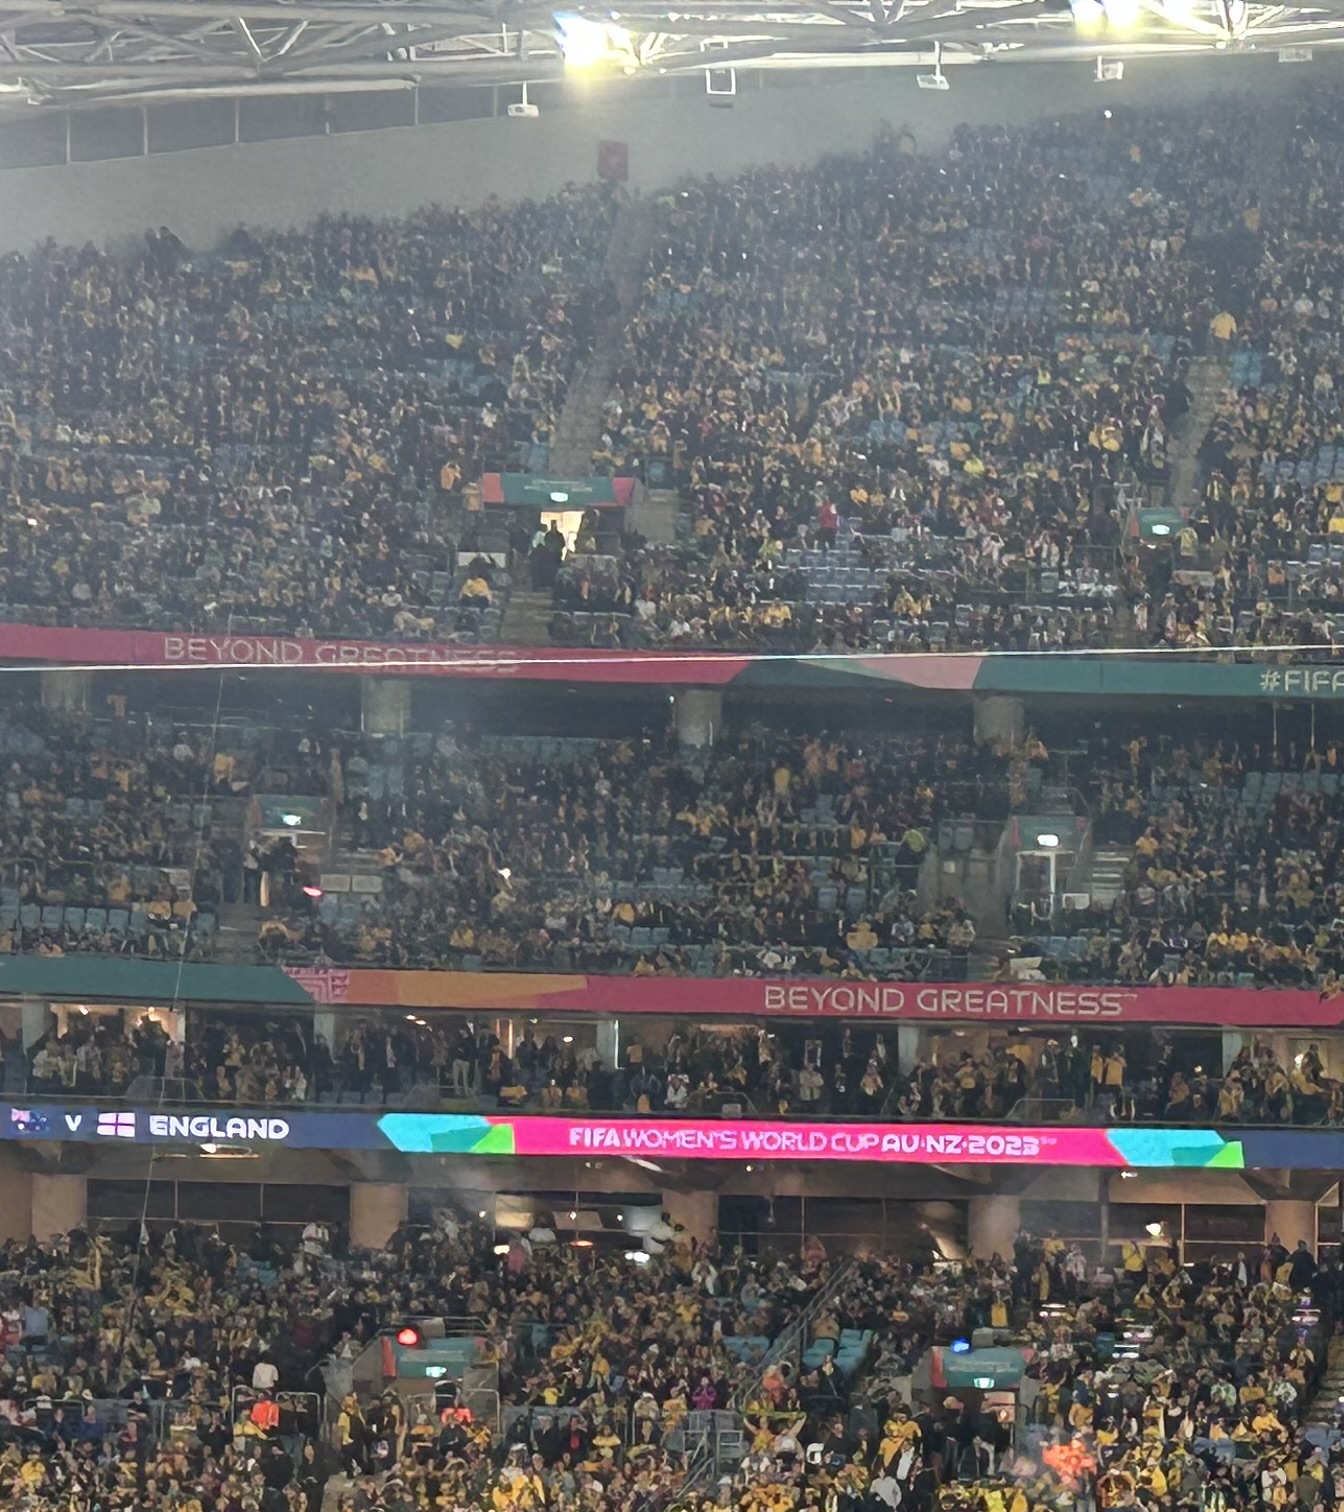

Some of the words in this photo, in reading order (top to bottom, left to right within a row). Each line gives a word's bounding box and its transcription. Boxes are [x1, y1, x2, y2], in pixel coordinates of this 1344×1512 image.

[164, 637, 303, 664] BEYOND
[765, 986, 904, 1013] BEYOND
[150, 1115, 290, 1139] ENGLAND
[569, 1127, 621, 1148] FIFA
[623, 1128, 738, 1150] WOMEN'S
[741, 1130, 828, 1152] WORLD
[831, 1132, 879, 1153] CUP
